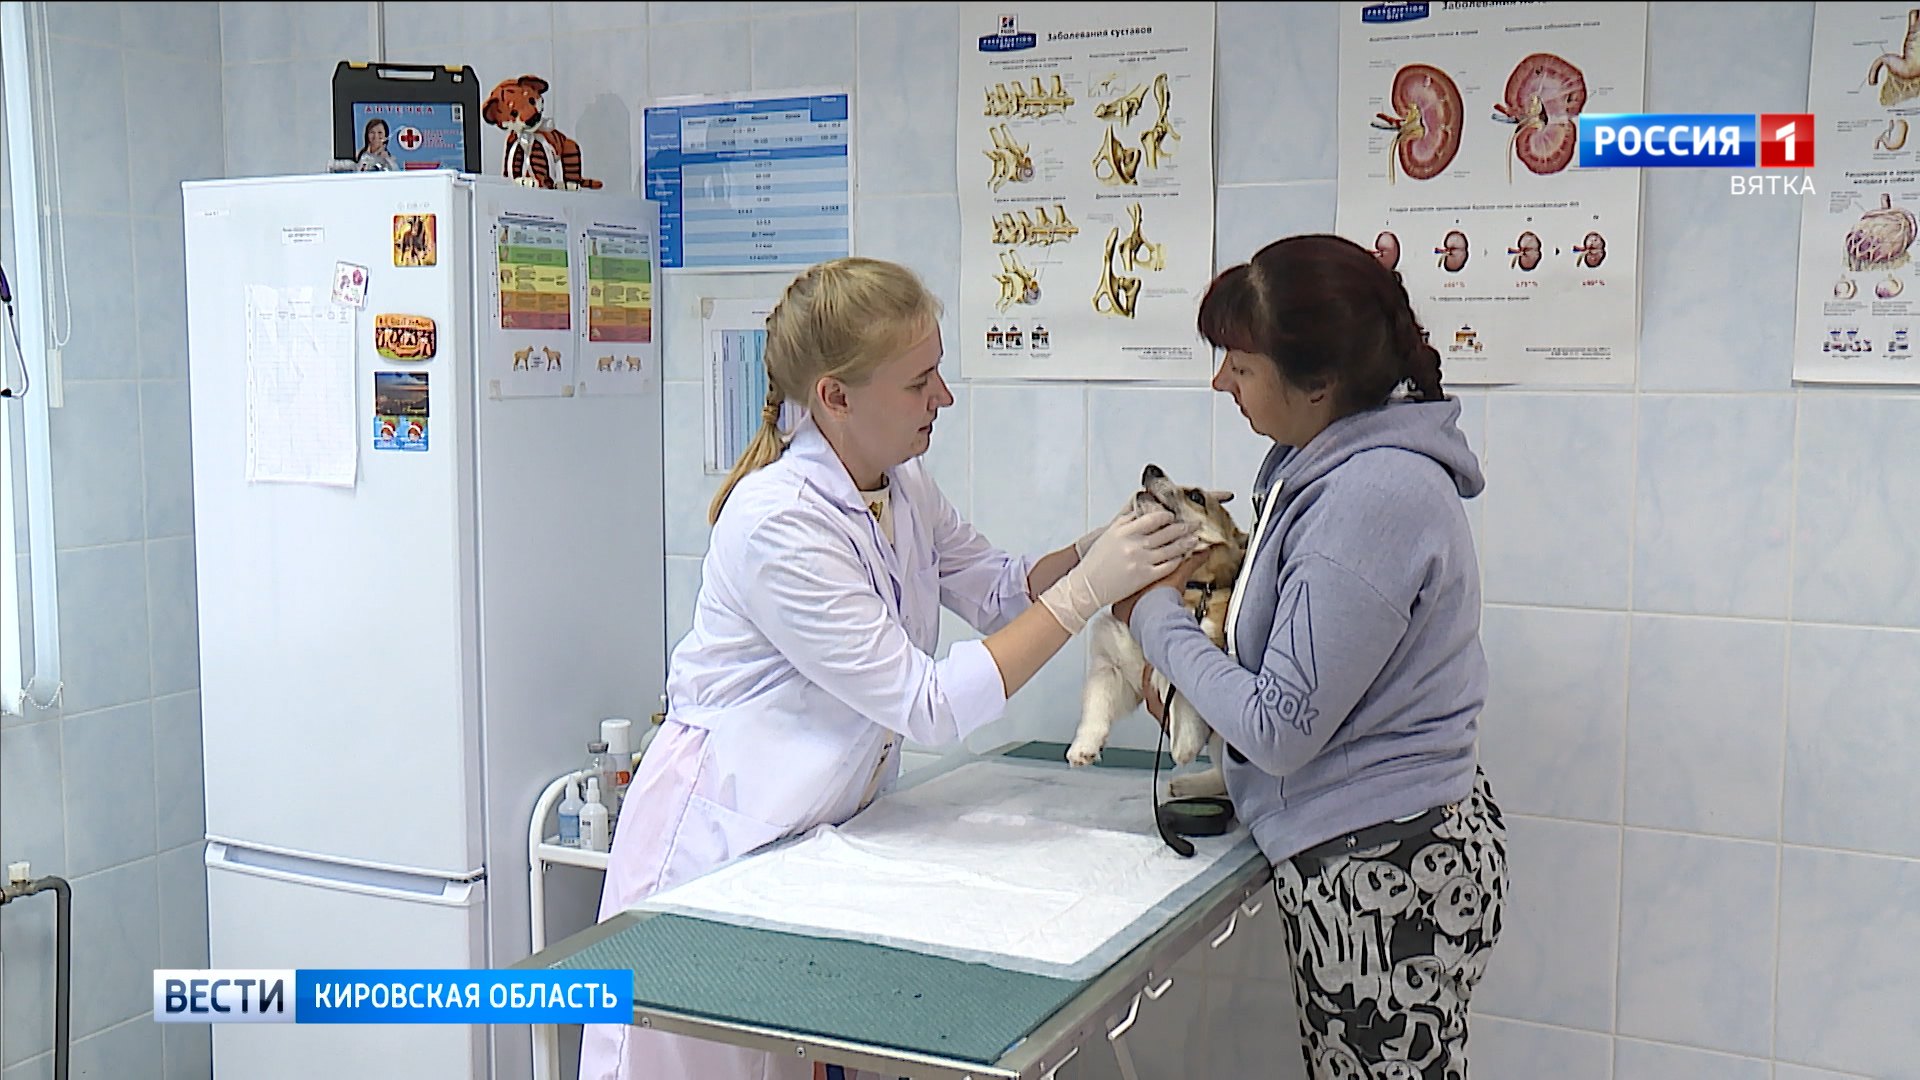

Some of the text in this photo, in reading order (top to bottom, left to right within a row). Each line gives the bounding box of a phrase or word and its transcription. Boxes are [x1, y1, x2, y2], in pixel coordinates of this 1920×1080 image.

[1047, 26, 1153, 42] Заболевания суставов
[364, 105, 435, 115] АПТЕЧКА
